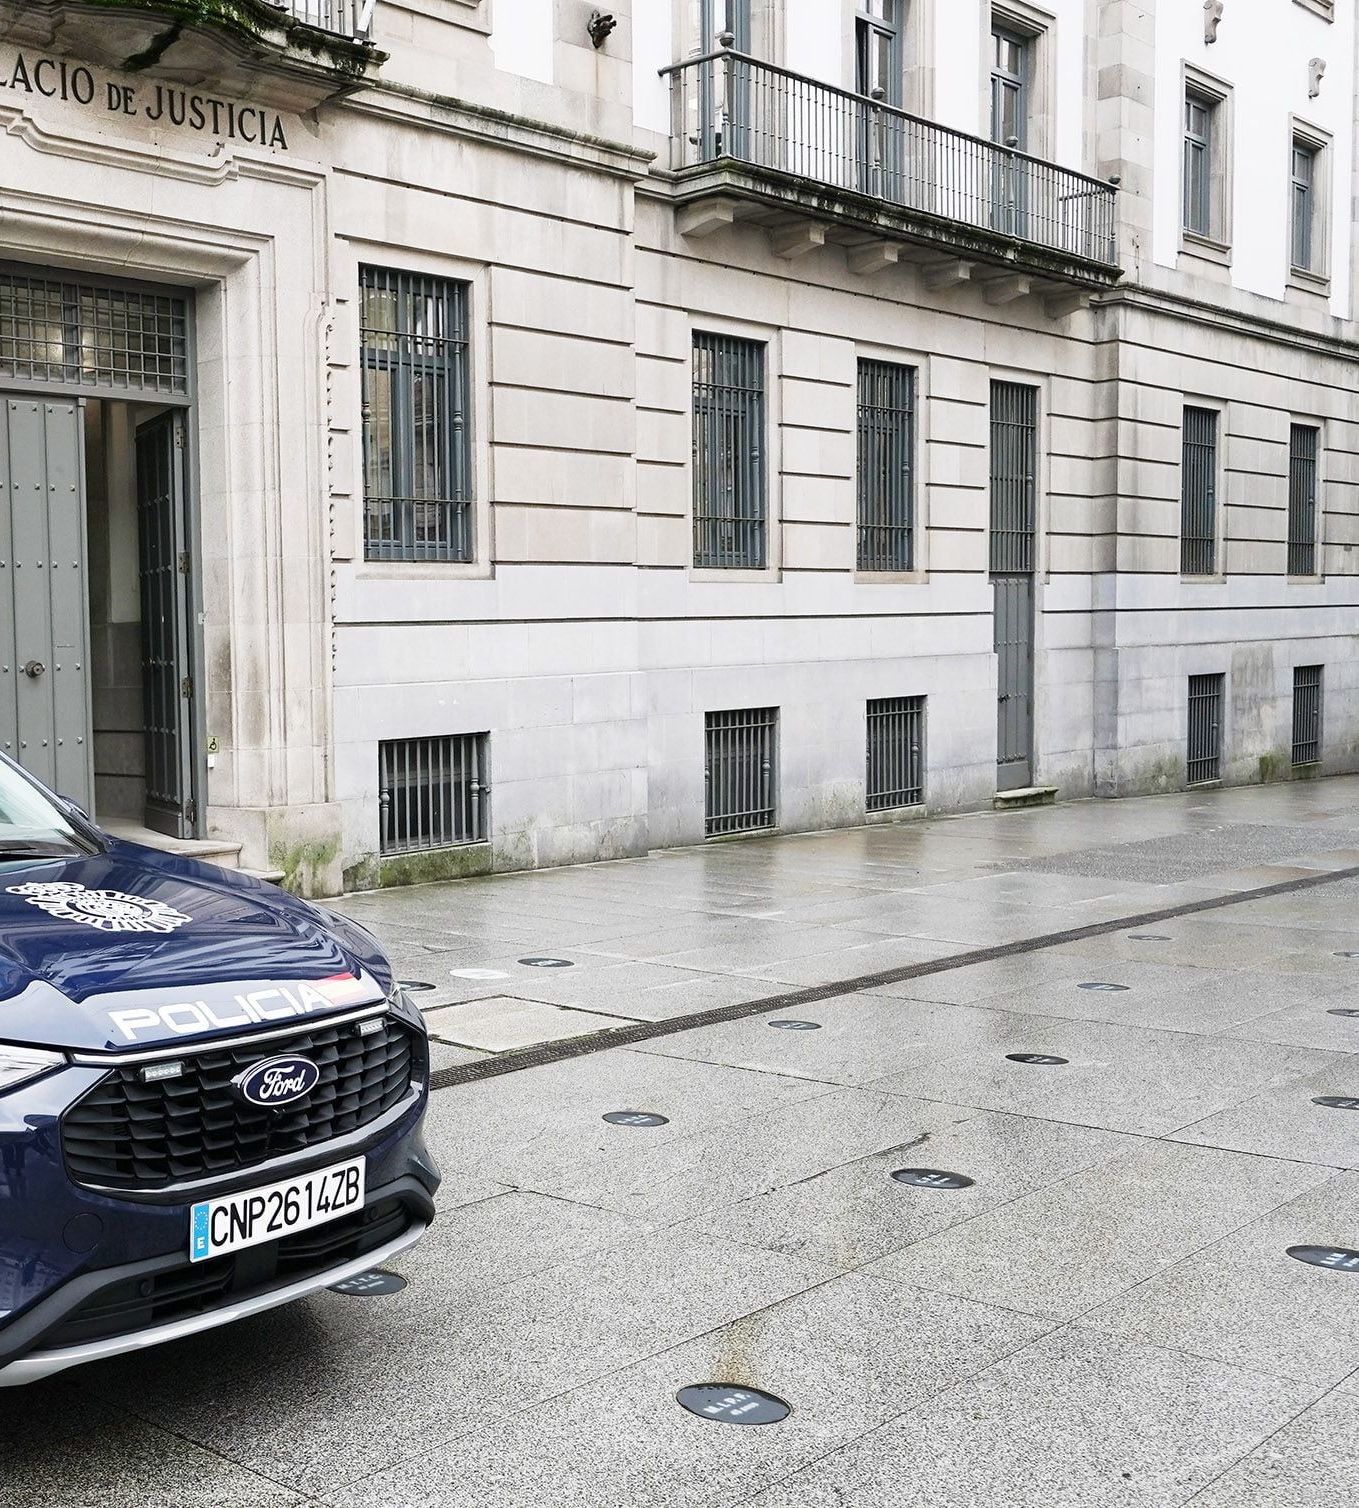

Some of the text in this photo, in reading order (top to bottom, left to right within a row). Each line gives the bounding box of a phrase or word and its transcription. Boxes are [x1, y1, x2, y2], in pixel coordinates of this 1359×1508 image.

[107, 82, 138, 115] DE
[145, 86, 288, 150] JUSTICIA
[108, 983, 335, 1040] POLICIA
[259, 1065, 307, 1100] Ford
[210, 1165, 360, 1247] CNP2614ZB
[197, 1236, 205, 1250] E
